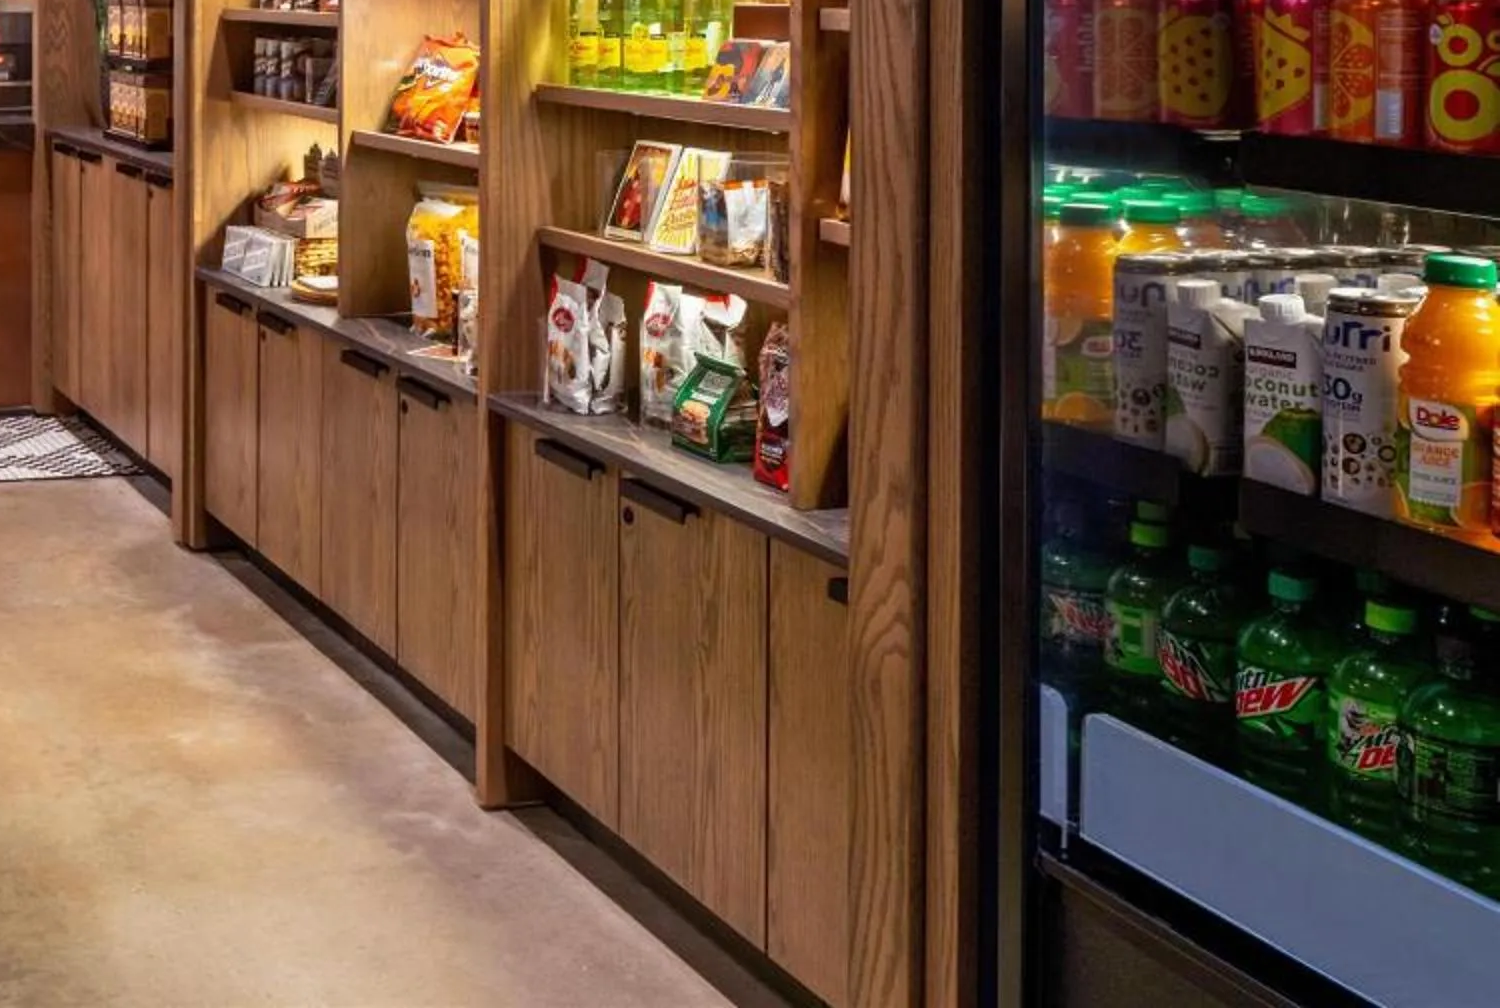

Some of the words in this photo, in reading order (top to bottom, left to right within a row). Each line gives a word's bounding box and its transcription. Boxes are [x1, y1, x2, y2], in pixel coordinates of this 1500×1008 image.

[1325, 321, 1392, 353] urri
[1245, 376, 1320, 398] oconut
[1417, 406, 1460, 426] Dole
